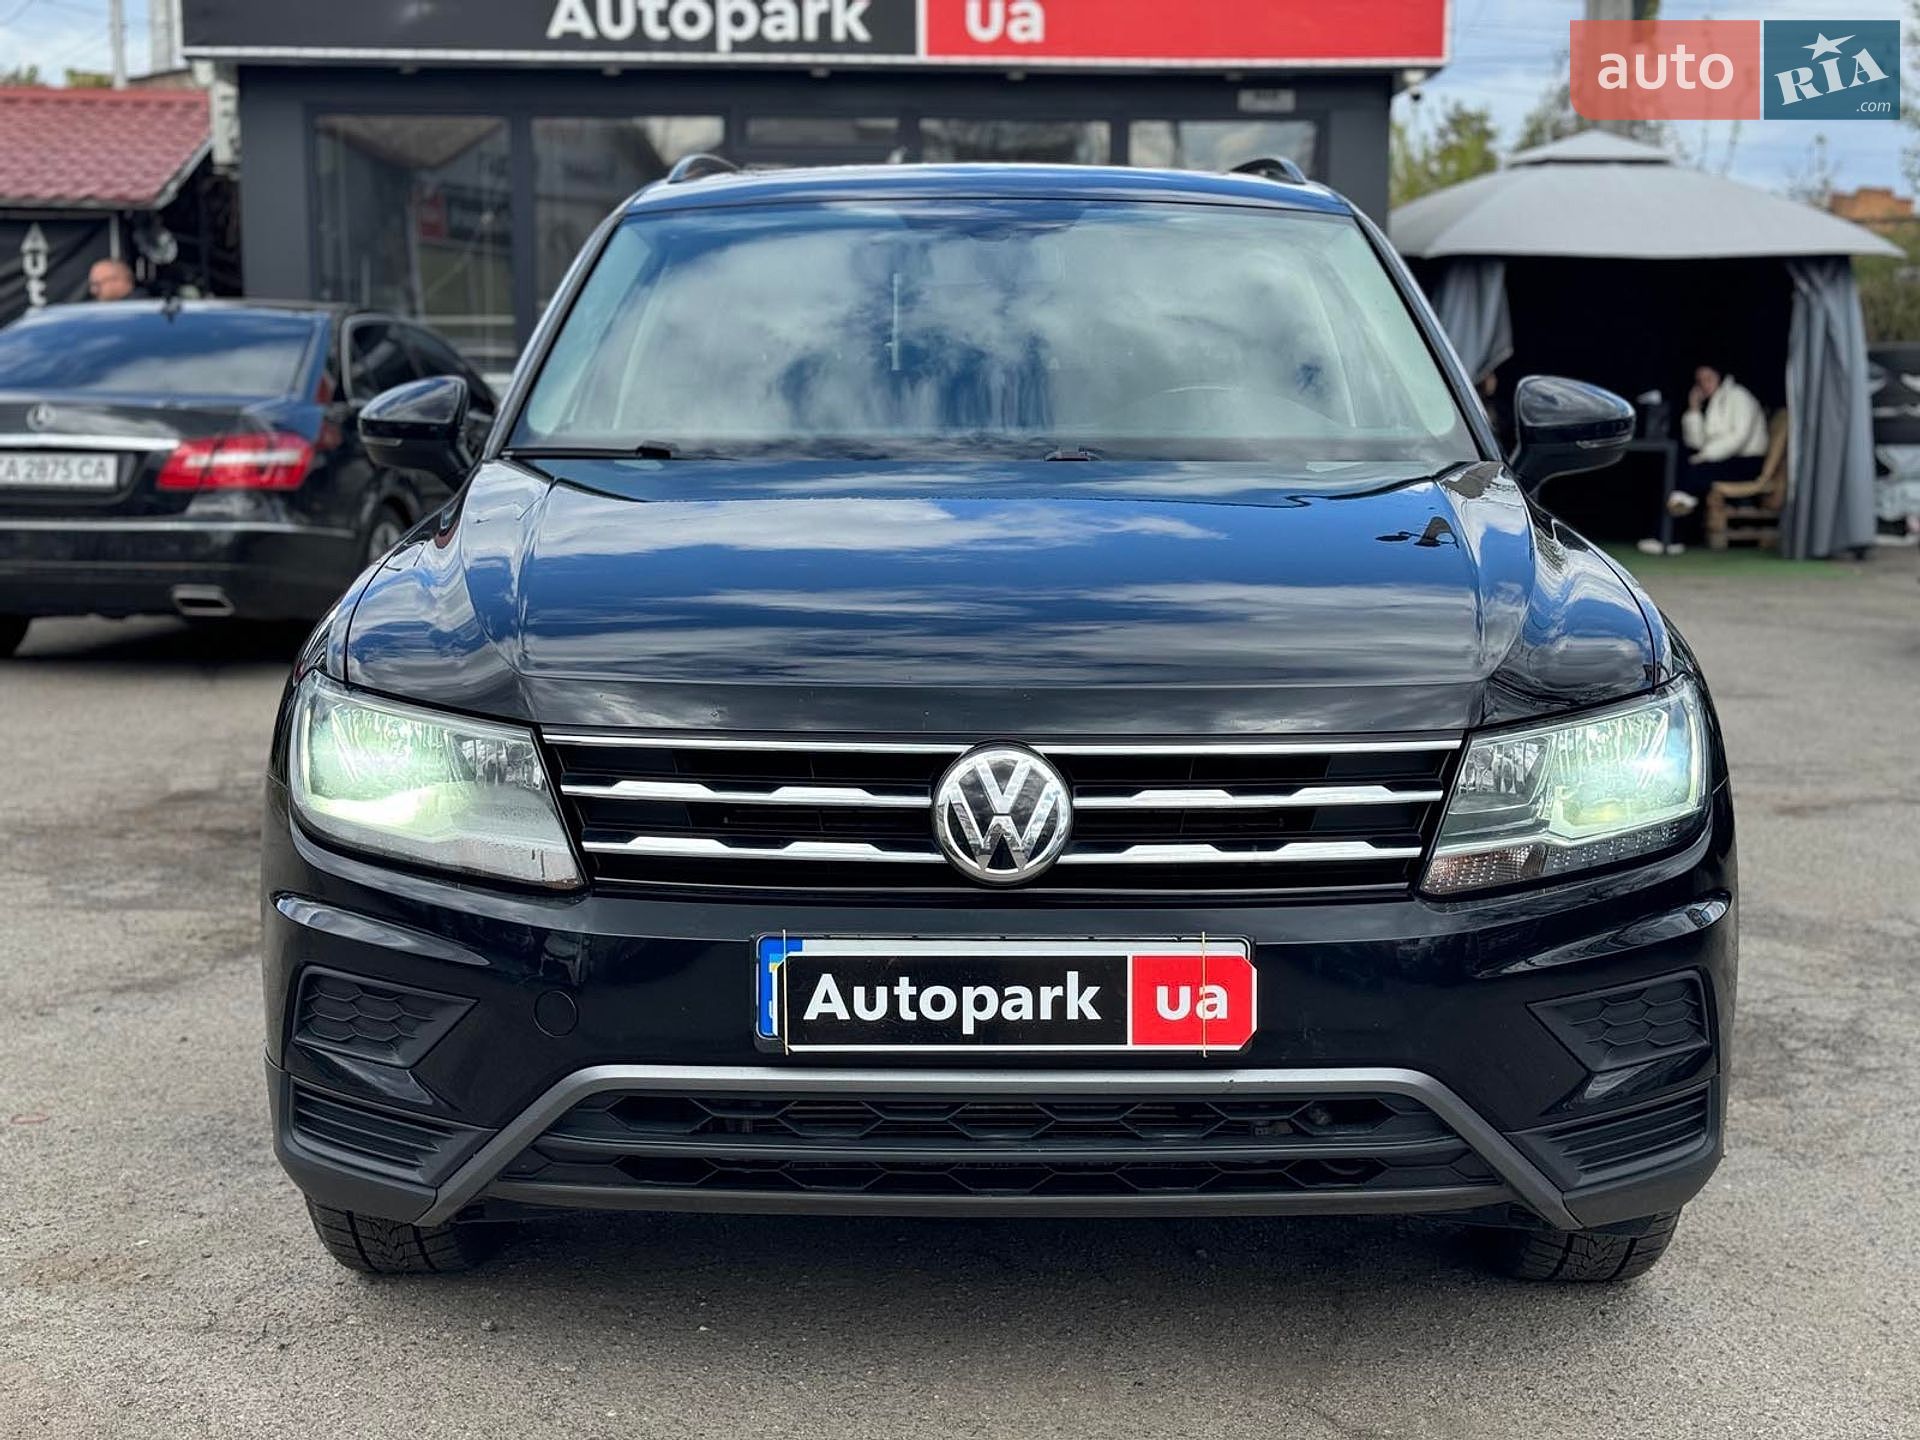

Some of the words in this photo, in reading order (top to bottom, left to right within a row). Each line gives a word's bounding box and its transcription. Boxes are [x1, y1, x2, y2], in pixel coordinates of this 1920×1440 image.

[545, 0, 873, 52] Autopark
[964, 0, 1046, 43] ua
[78, 459, 108, 481] CA
[803, 971, 1102, 1036] Autopark
[1155, 984, 1229, 1021] ua
